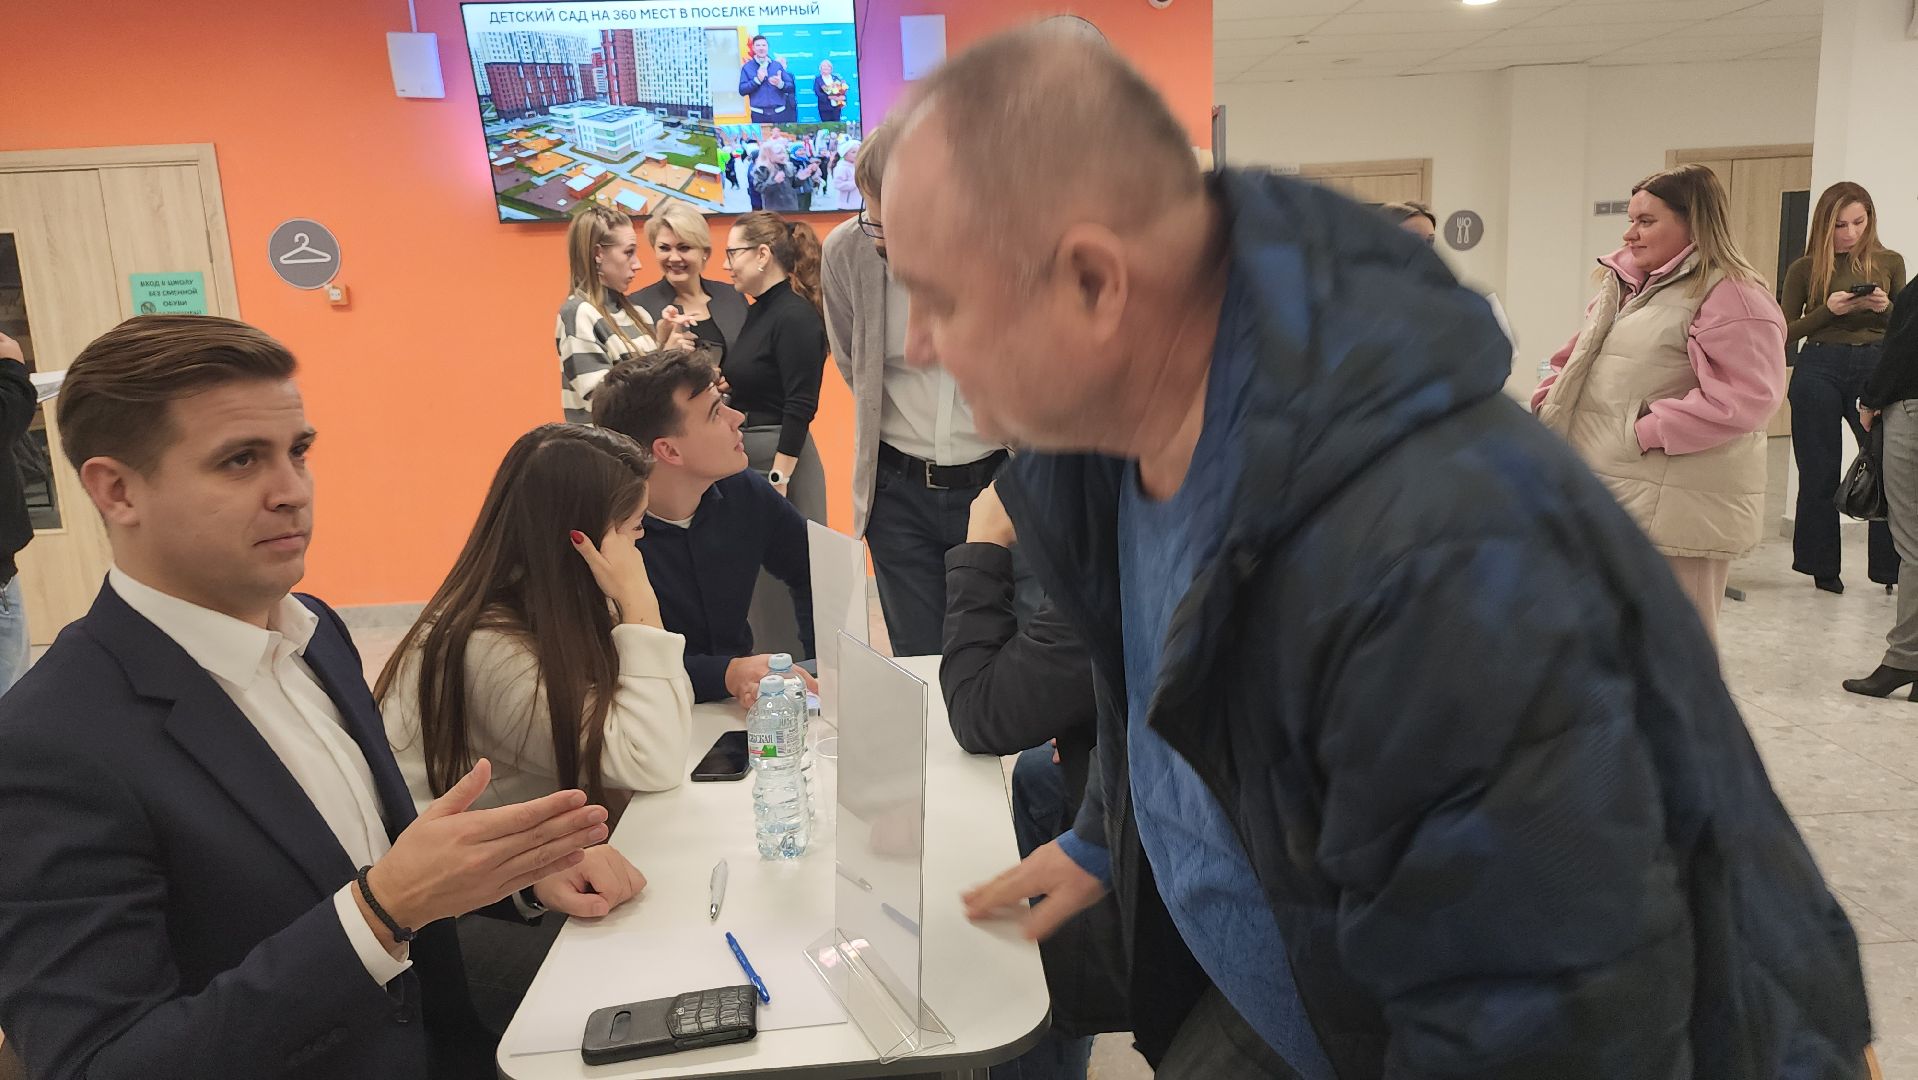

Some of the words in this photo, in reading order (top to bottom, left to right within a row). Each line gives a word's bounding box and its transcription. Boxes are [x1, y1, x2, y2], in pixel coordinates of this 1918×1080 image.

[490, 8, 555, 24] ДЕТСКИЙ
[559, 10, 588, 23] САД
[592, 10, 610, 20] НА
[613, 9, 637, 20] 360
[640, 8, 676, 20] МЕСТ
[680, 8, 688, 19] В
[692, 6, 756, 18] ПОСЕЛКЕ
[759, 1, 820, 16] МИРНЫЙ
[162, 288, 198, 297] СМЕННОЙ
